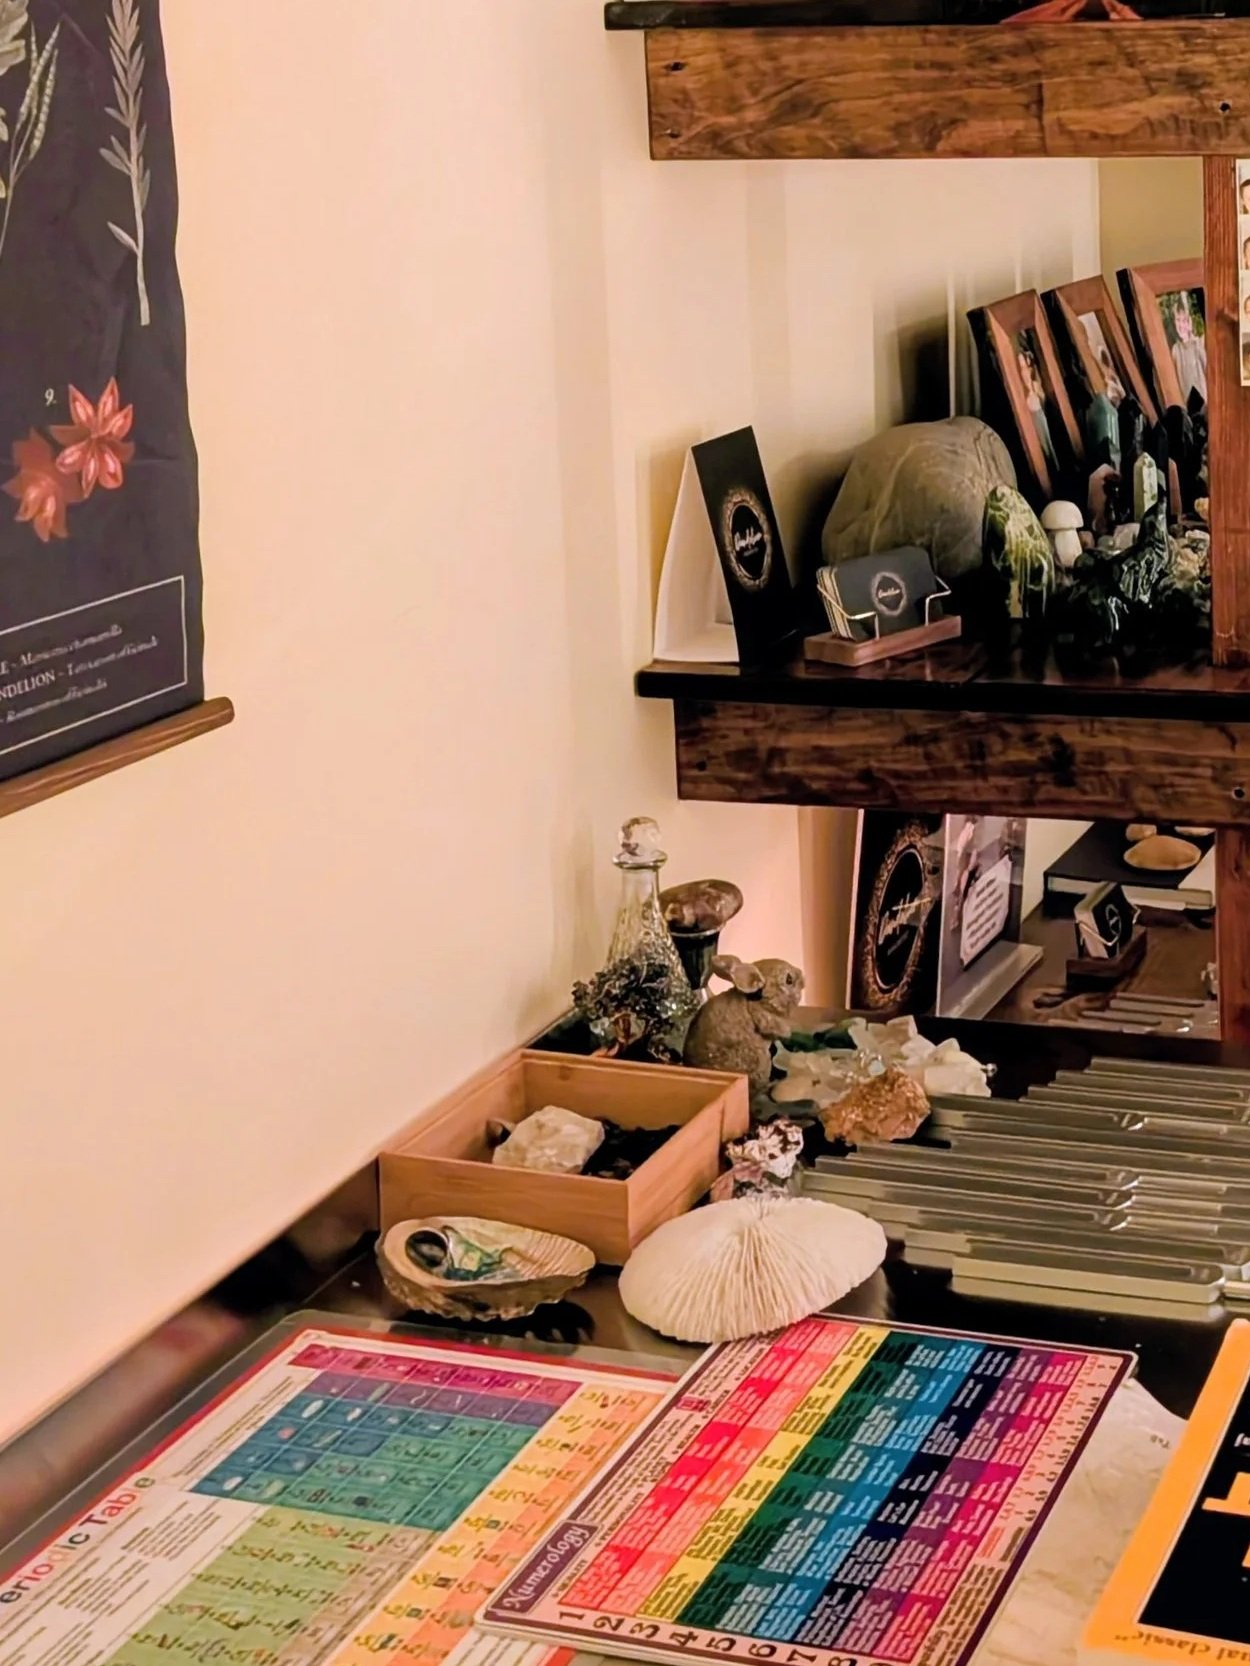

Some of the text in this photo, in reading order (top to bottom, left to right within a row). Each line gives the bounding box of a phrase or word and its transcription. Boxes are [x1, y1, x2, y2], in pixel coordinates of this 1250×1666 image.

[79, 1477, 156, 1528] Table
[503, 1524, 591, 1609] Numerology
[559, 1610, 585, 1621] 1
[593, 1616, 625, 1631] 2
[630, 1622, 660, 1639] 3
[669, 1628, 699, 1647] 4
[705, 1636, 736, 1654] 5
[748, 1643, 778, 1659] 6
[786, 1649, 818, 1664] 7
